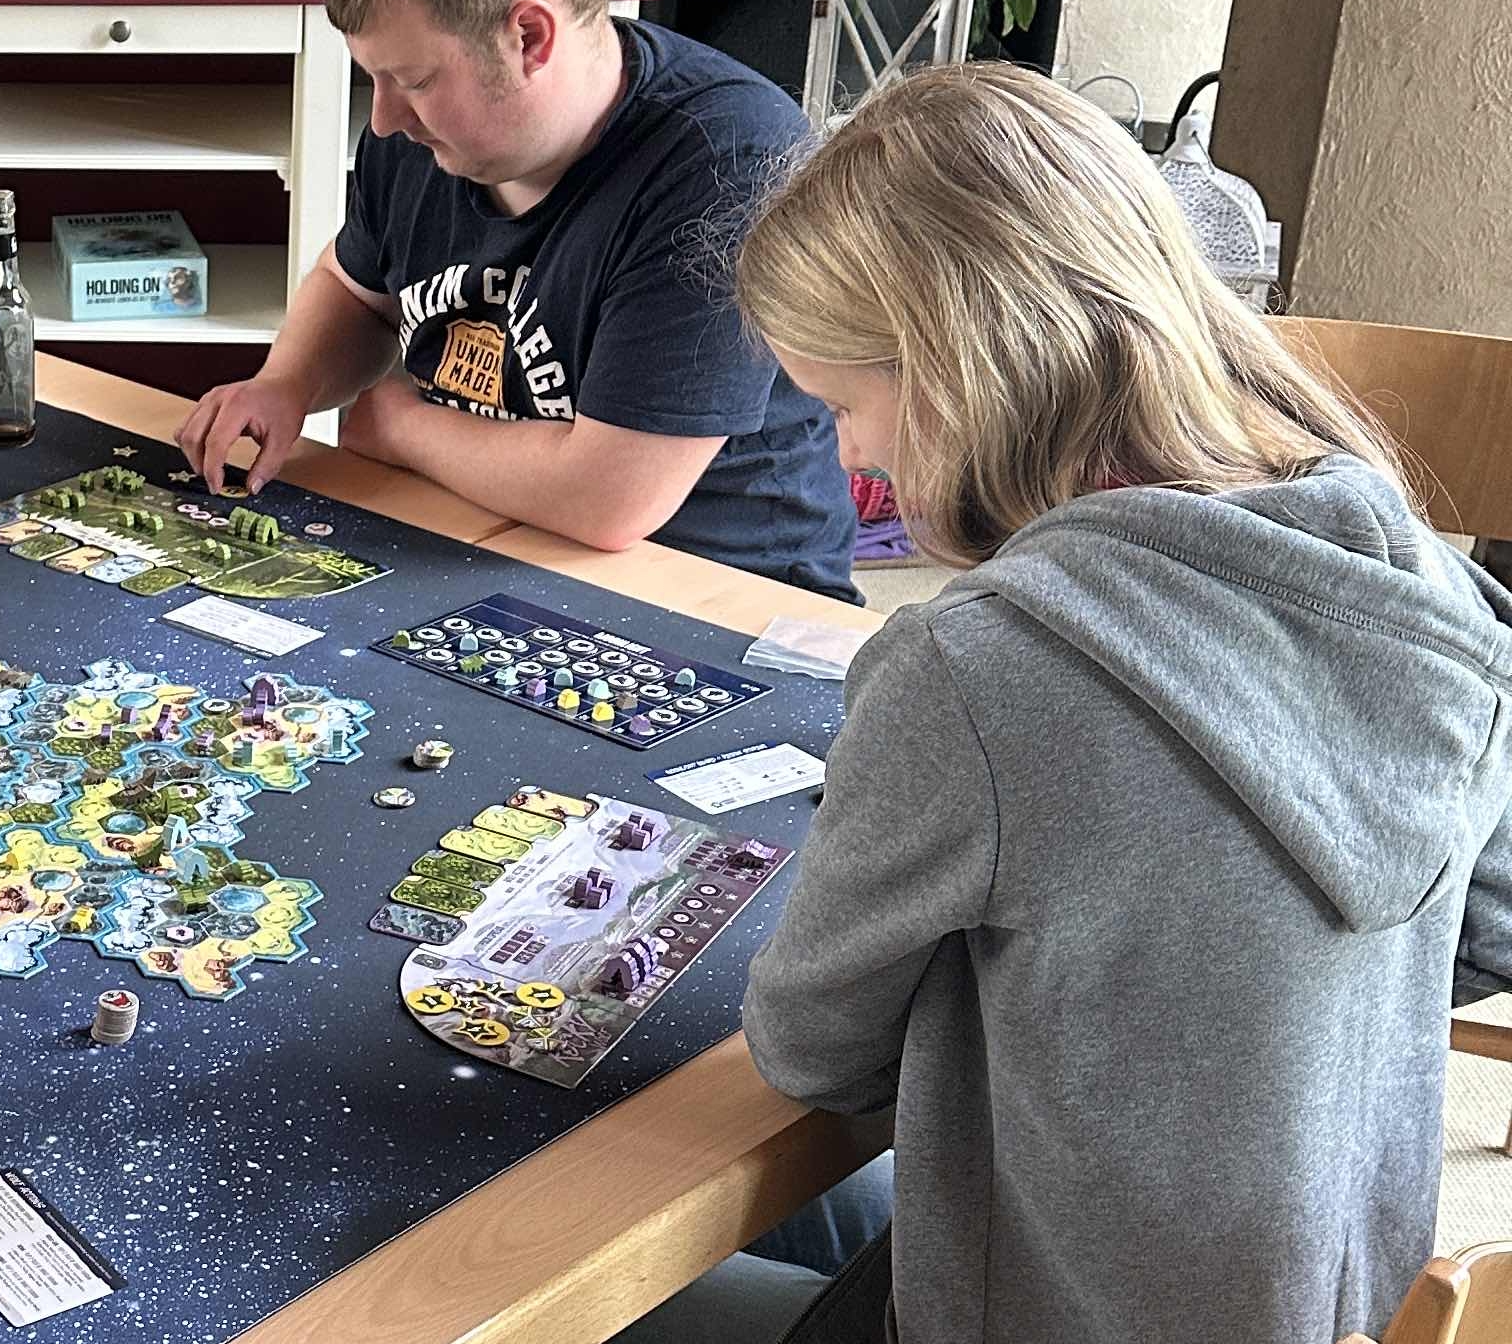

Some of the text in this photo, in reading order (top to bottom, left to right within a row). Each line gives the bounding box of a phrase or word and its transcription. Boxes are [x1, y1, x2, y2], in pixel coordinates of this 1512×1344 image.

[86, 277, 161, 297] HOLDING ON
[449, 361, 496, 397] MADE
